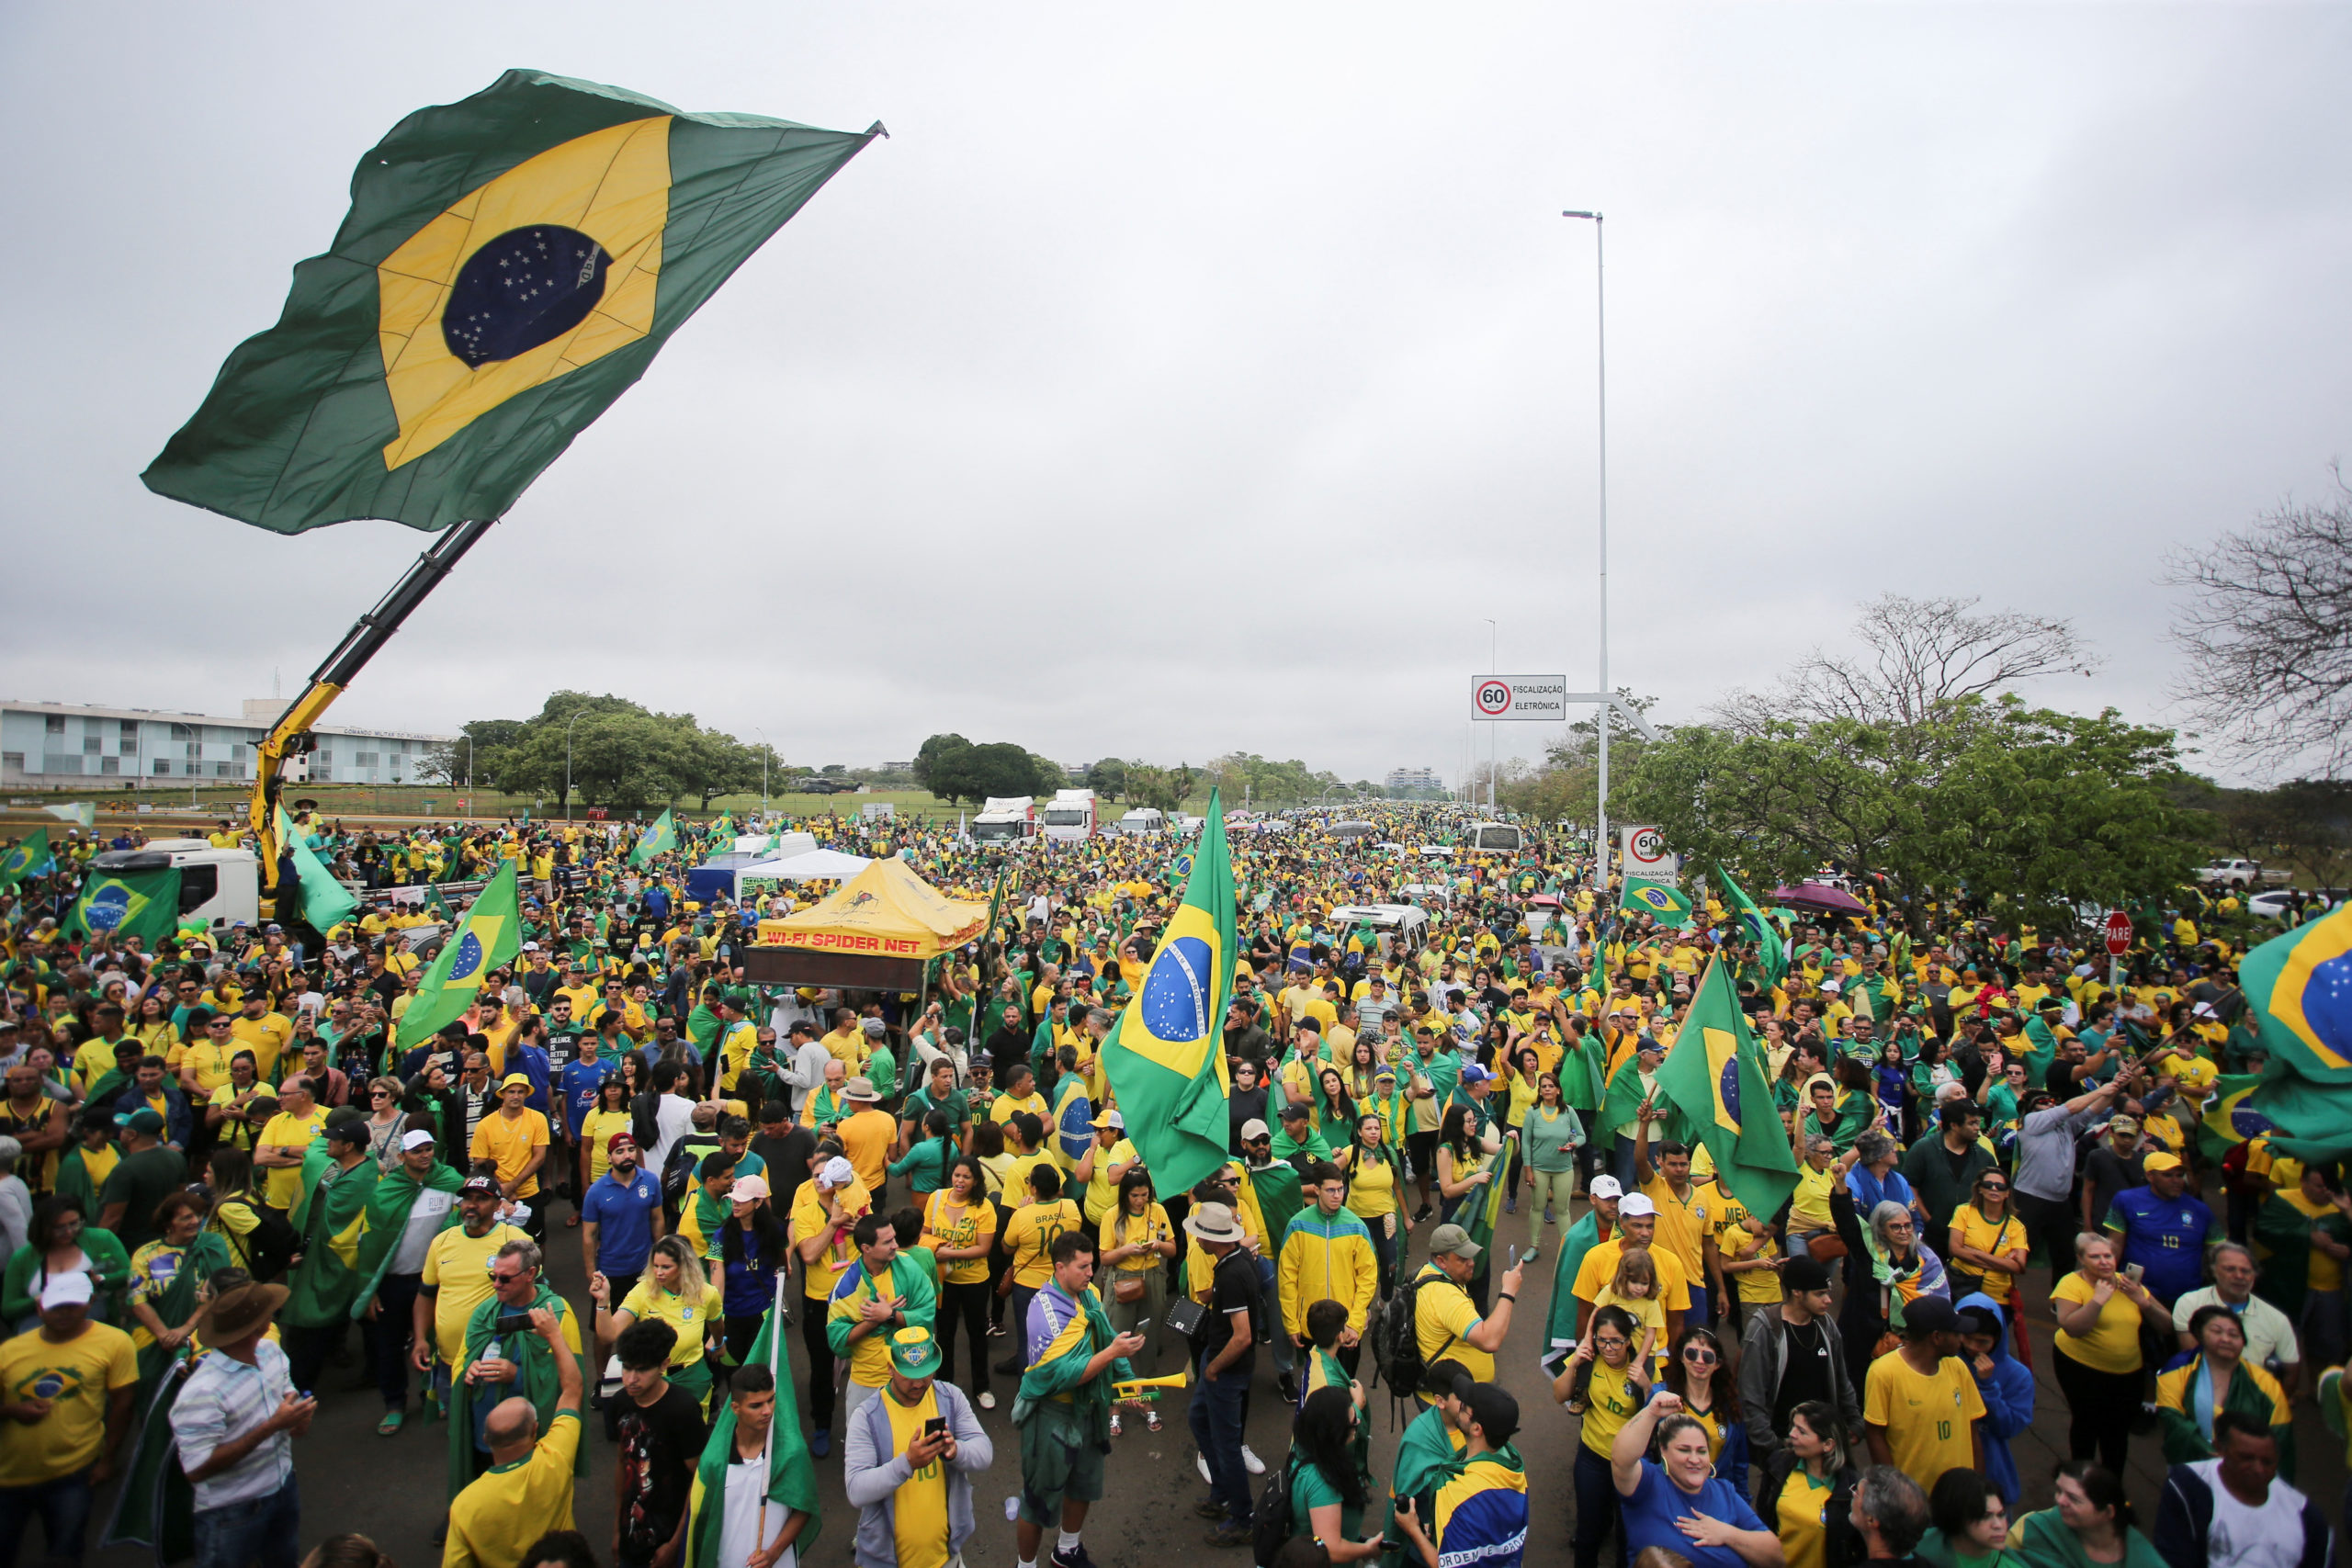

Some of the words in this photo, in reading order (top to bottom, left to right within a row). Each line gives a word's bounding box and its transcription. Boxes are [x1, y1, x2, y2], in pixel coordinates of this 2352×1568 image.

[1512, 684, 1563, 694] FISCALIZAÇÃO
[1482, 689, 1505, 704] 60
[1515, 701, 1560, 710] ELETRÔNICA
[1639, 836, 1658, 848] 60
[2106, 927, 2130, 942] PARE
[767, 931, 808, 945] WI-FI
[811, 933, 878, 951] SPIDER
[884, 939, 921, 953] NET
[1191, 978, 1204, 1034] PROGRESSO
[550, 1035, 571, 1044] SILENCE
[971, 1112, 981, 1125] 10
[429, 1196, 444, 1207] RUN
[1035, 1213, 1066, 1223] BRASIL
[2162, 1235, 2178, 1248] 10
[1608, 1396, 1623, 1415] 10
[1937, 1420, 1951, 1440] 10
[1487, 1546, 1494, 1555] E
